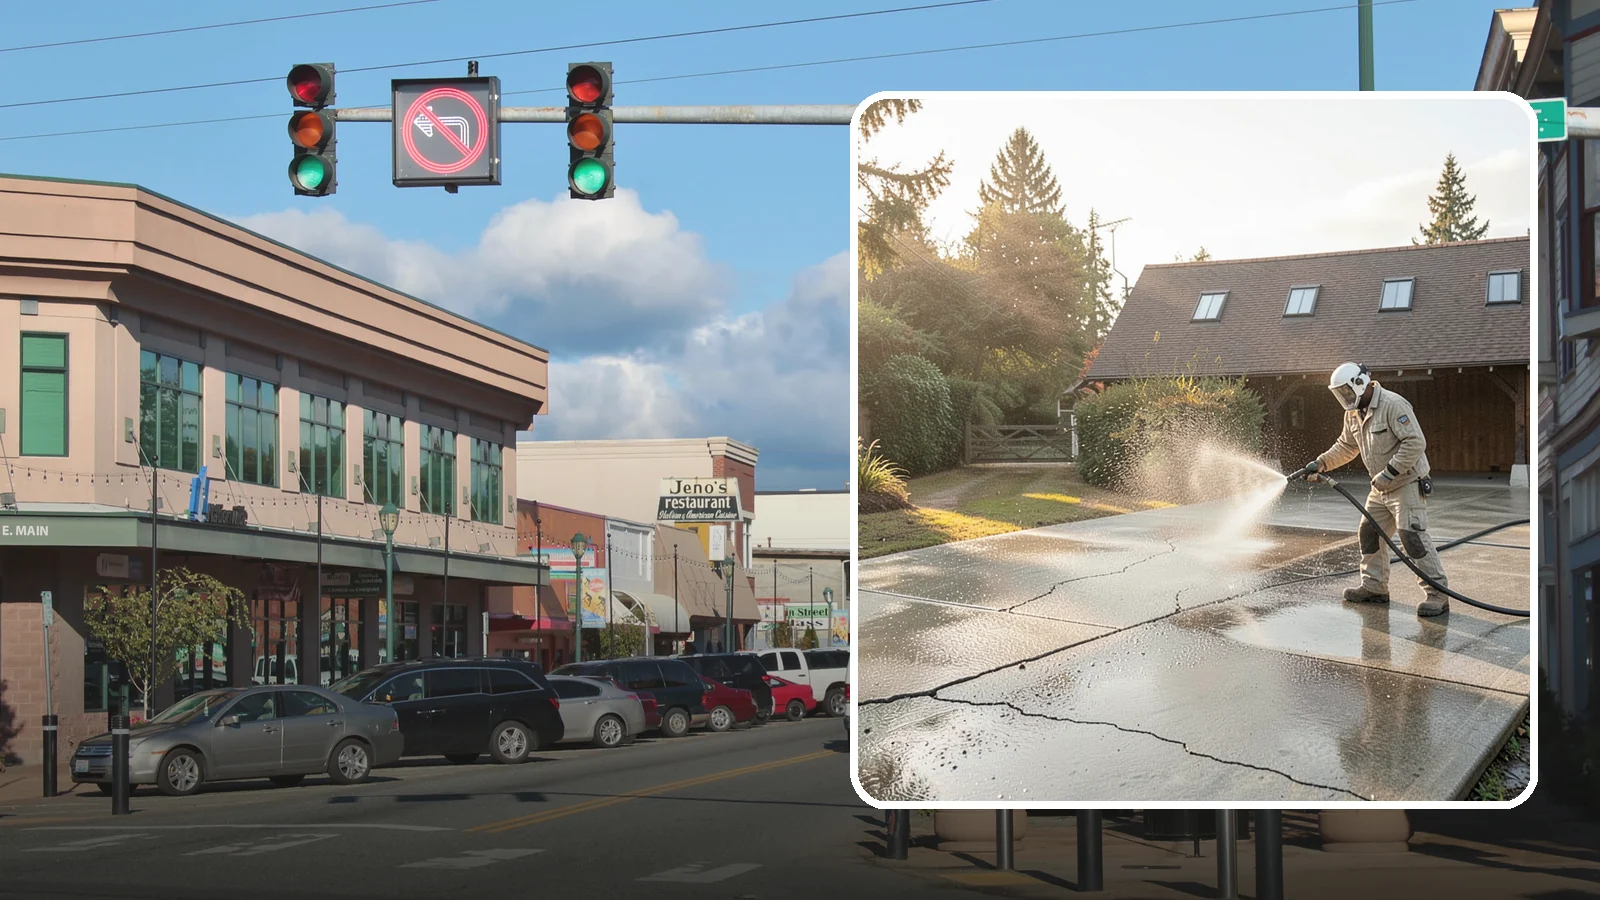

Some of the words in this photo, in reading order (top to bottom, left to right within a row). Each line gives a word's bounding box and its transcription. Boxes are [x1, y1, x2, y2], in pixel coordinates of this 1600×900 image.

[670, 480, 727, 494] Jeno's
[665, 496, 731, 509] restaurant
[658, 510, 682, 520] Italian
[686, 509, 714, 520] American
[714, 509, 737, 520] Cuisine
[2, 525, 13, 536] E.
[15, 525, 49, 536] MAIN
[797, 607, 828, 617] Street
[790, 619, 824, 627] lass
